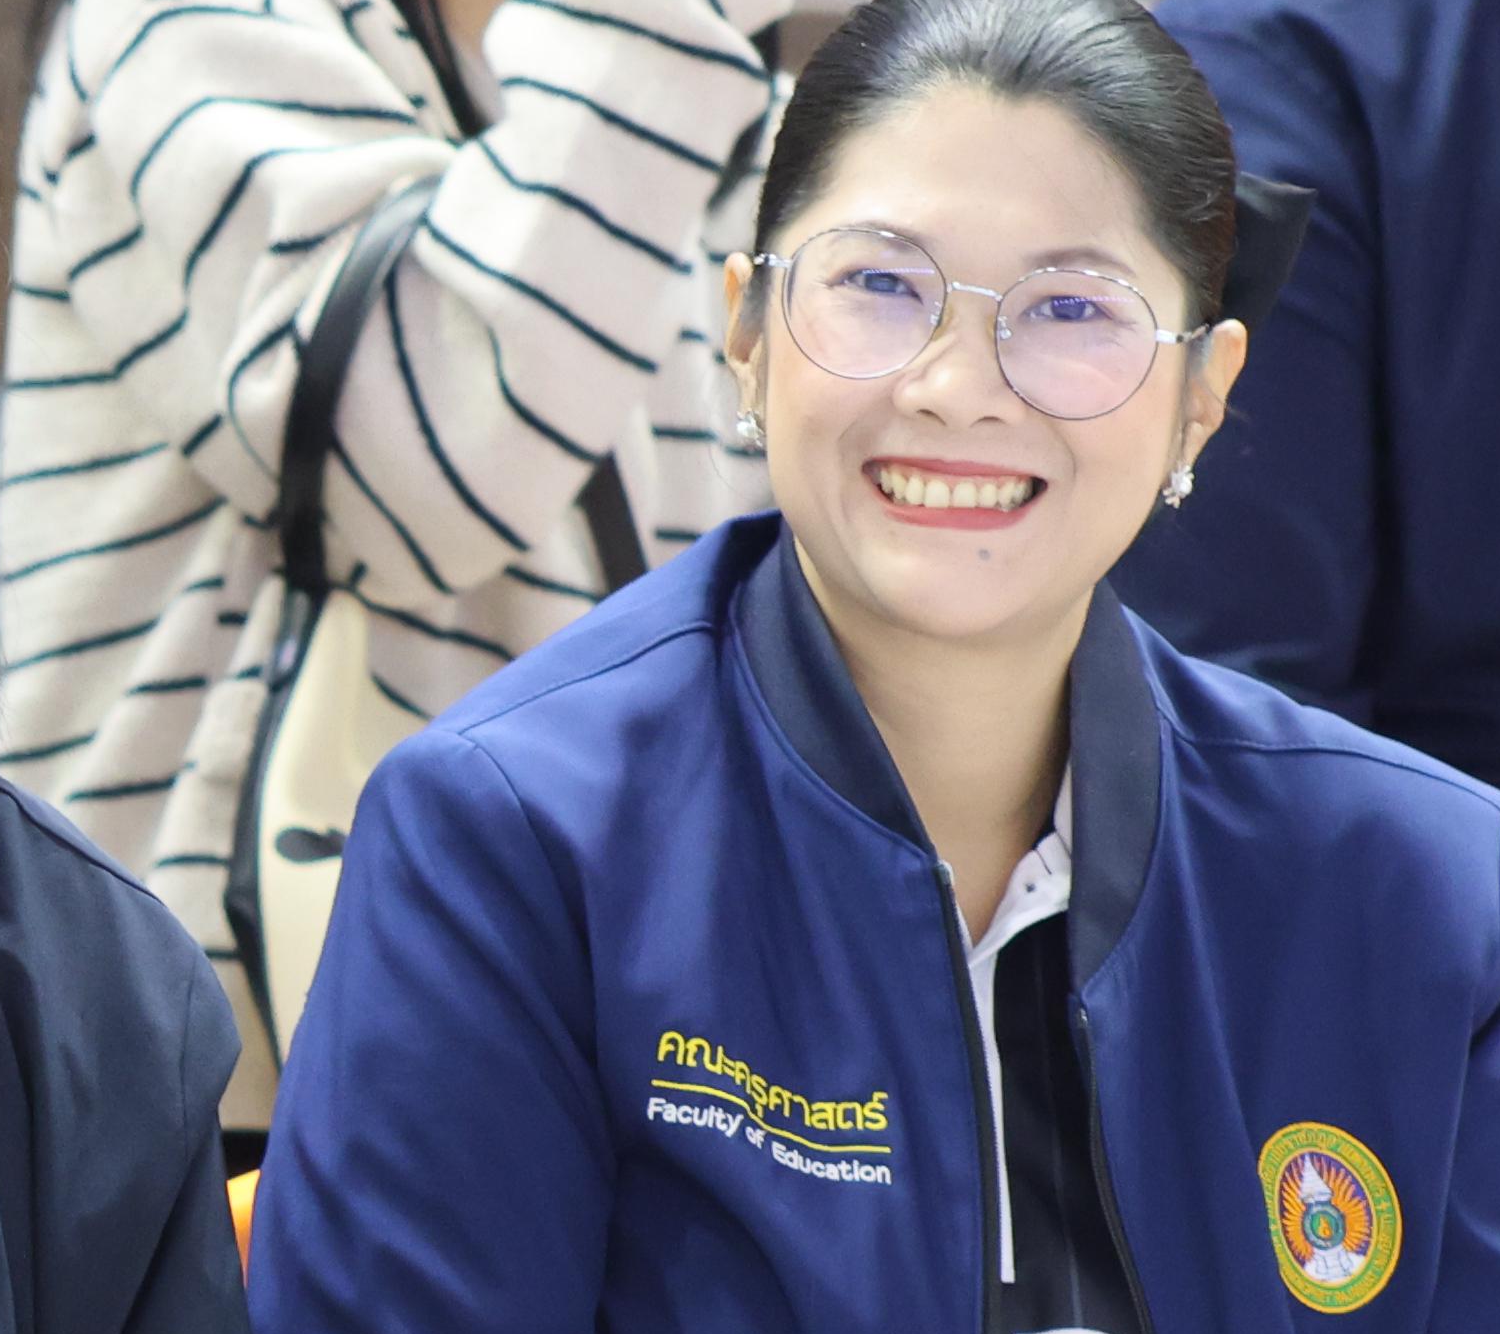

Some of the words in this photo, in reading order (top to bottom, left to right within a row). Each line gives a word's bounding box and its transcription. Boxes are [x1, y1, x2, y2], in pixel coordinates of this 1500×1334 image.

[656, 1031, 889, 1130] คณะครุศาสตร์
[647, 1097, 744, 1138] Faculty
[745, 1125, 767, 1148] of
[772, 1144, 892, 1185] Education
